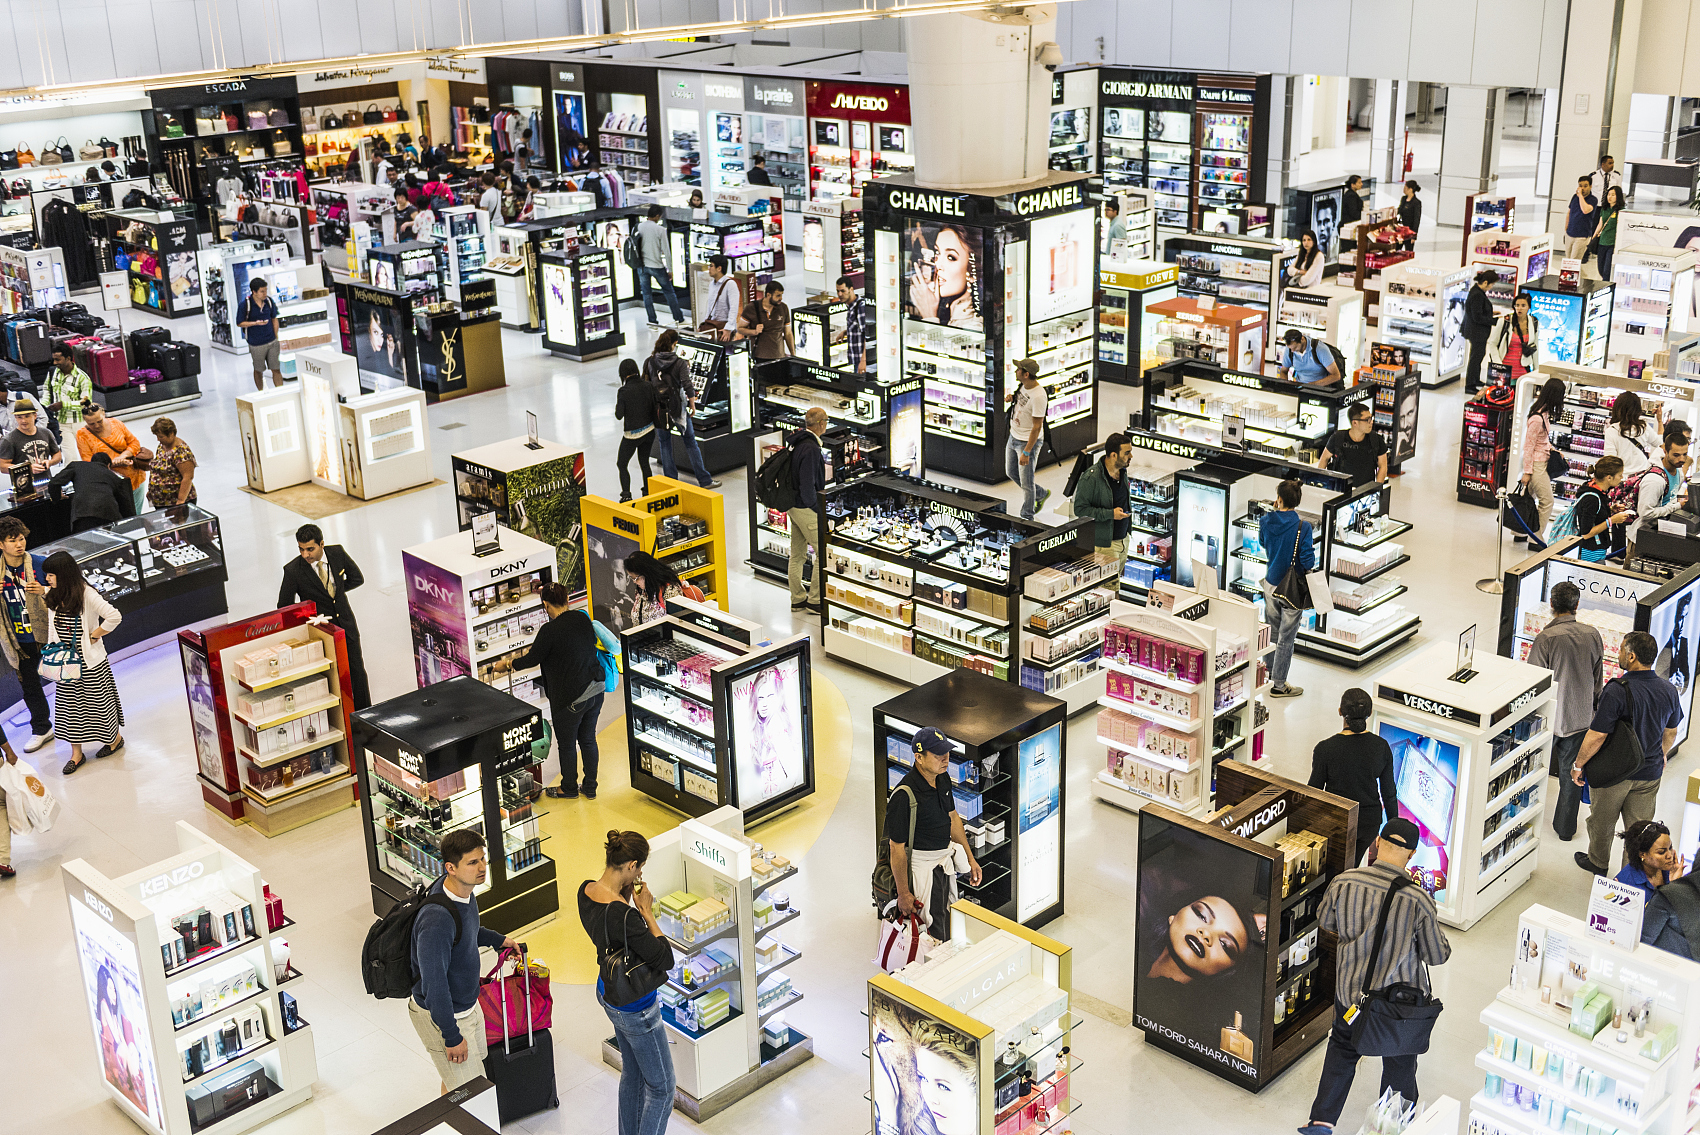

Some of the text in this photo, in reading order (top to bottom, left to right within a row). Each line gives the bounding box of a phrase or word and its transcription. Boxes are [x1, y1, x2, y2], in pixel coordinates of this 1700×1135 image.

[205, 82, 247, 94] ESCADA
[753, 85, 764, 100] la
[1102, 81, 1193, 101] GIORGIO ARMANI
[830, 93, 889, 111] SHISEIDO
[718, 193, 742, 202] SHISEIDO
[889, 190, 966, 217] CHANEL
[1017, 185, 1082, 216] CHANEL
[807, 204, 834, 214] SHISEIDO
[13, 236, 29, 244] MONT
[1637, 260, 1672, 270] SWAROVSKI
[1146, 270, 1174, 286] LOEWE
[1532, 296, 1571, 306] AZZARO
[793, 312, 822, 327] CHANEL
[440, 327, 462, 382] YSL
[305, 360, 322, 376] Dior
[890, 379, 922, 397] CHANEL
[1222, 373, 1263, 390] CHANEL
[1343, 389, 1370, 405] CHANEL
[1513, 412, 1521, 455] MAKE-UP
[1132, 435, 1197, 459] GIVENCHY
[466, 462, 492, 480] aramis
[647, 494, 679, 513] FENDI
[930, 499, 975, 522] GUERLAIN
[1192, 504, 1209, 513] PLAY
[612, 516, 640, 536] FENDI
[1038, 528, 1078, 553] GUERLAIN
[490, 558, 528, 579] DKNY
[414, 574, 455, 605] DKNY
[1567, 575, 1638, 603] ESCADA
[505, 604, 522, 614] DKNY
[245, 621, 281, 639] Cartier
[508, 639, 526, 649] DKNY
[512, 674, 529, 684] DKNY
[1402, 693, 1454, 719] VERSACE
[1510, 687, 1538, 712] VERSACE
[503, 722, 532, 742] MONT
[503, 734, 533, 751] BLANC
[916, 742, 923, 752] 3
[398, 748, 419, 765] MONT
[399, 758, 421, 777] BLANC
[1254, 798, 1287, 831] FORD
[139, 861, 205, 899] KENZO
[1597, 878, 1641, 898] Did you know?
[84, 888, 114, 923] KENZO
[947, 956, 1024, 1010] BVLGARI
[1135, 1014, 1258, 1080] TOM FORD SAHARA NOIR
